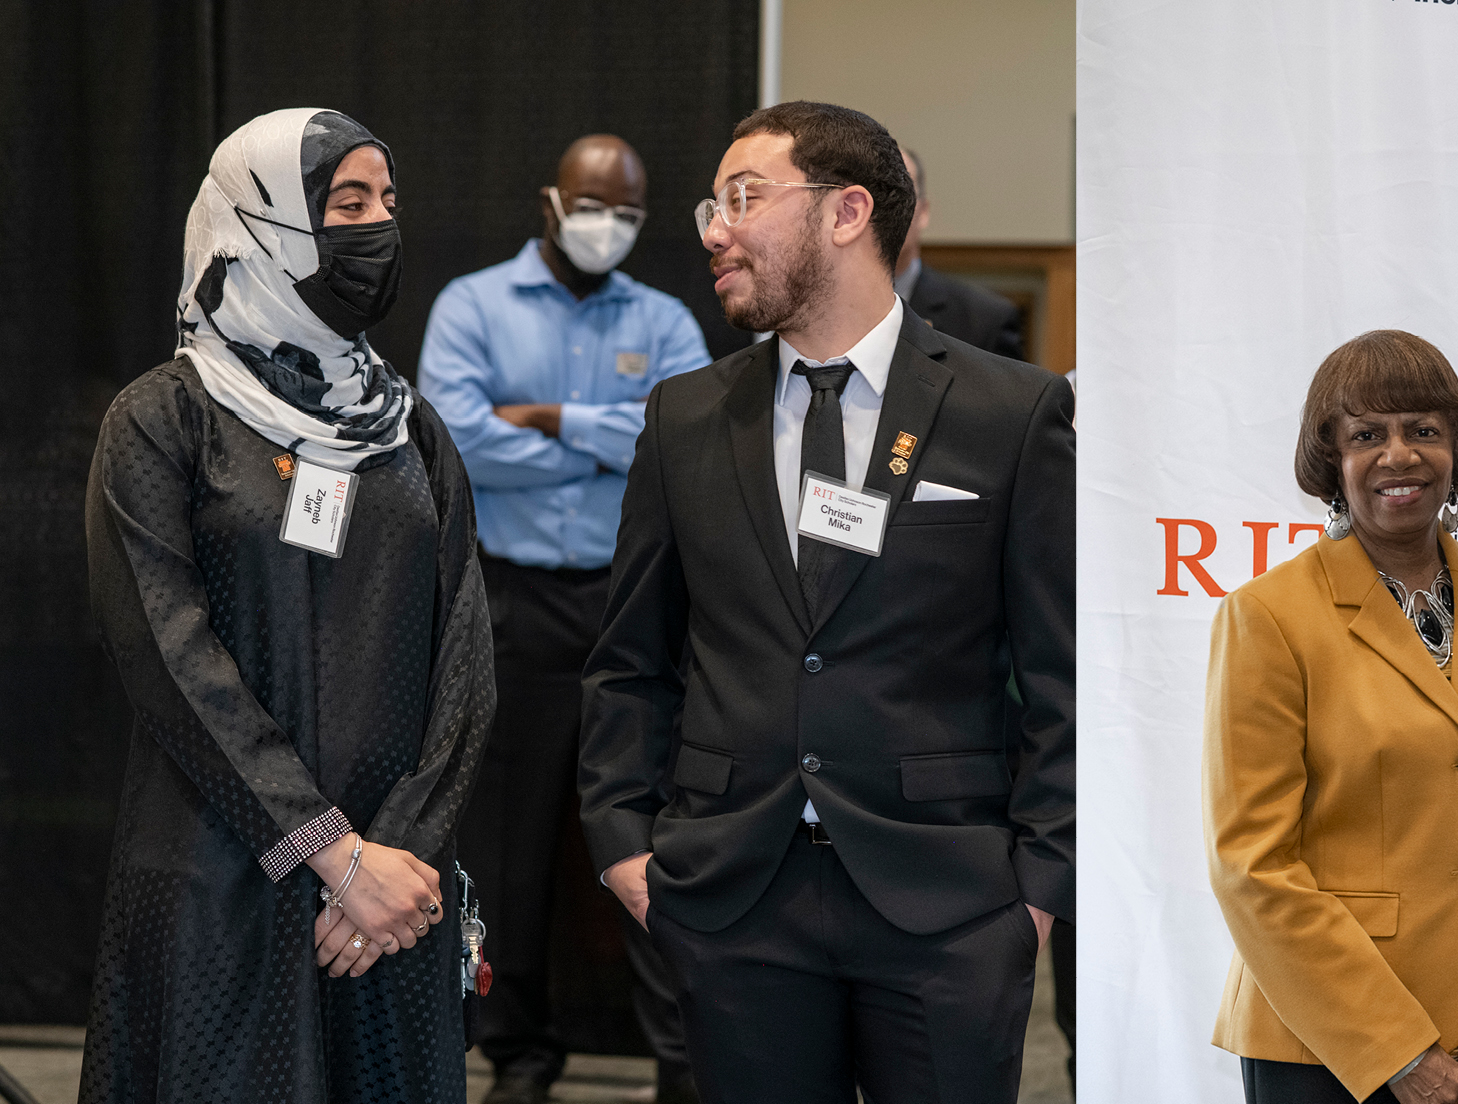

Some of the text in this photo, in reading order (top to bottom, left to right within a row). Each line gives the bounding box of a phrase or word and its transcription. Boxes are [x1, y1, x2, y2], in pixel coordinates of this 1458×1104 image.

[334, 480, 346, 502] RIT
[813, 486, 835, 500] RIT
[303, 495, 313, 514] Jaff
[312, 489, 326, 524] Zayneb
[820, 504, 862, 524] Christian
[828, 518, 850, 531] Mika
